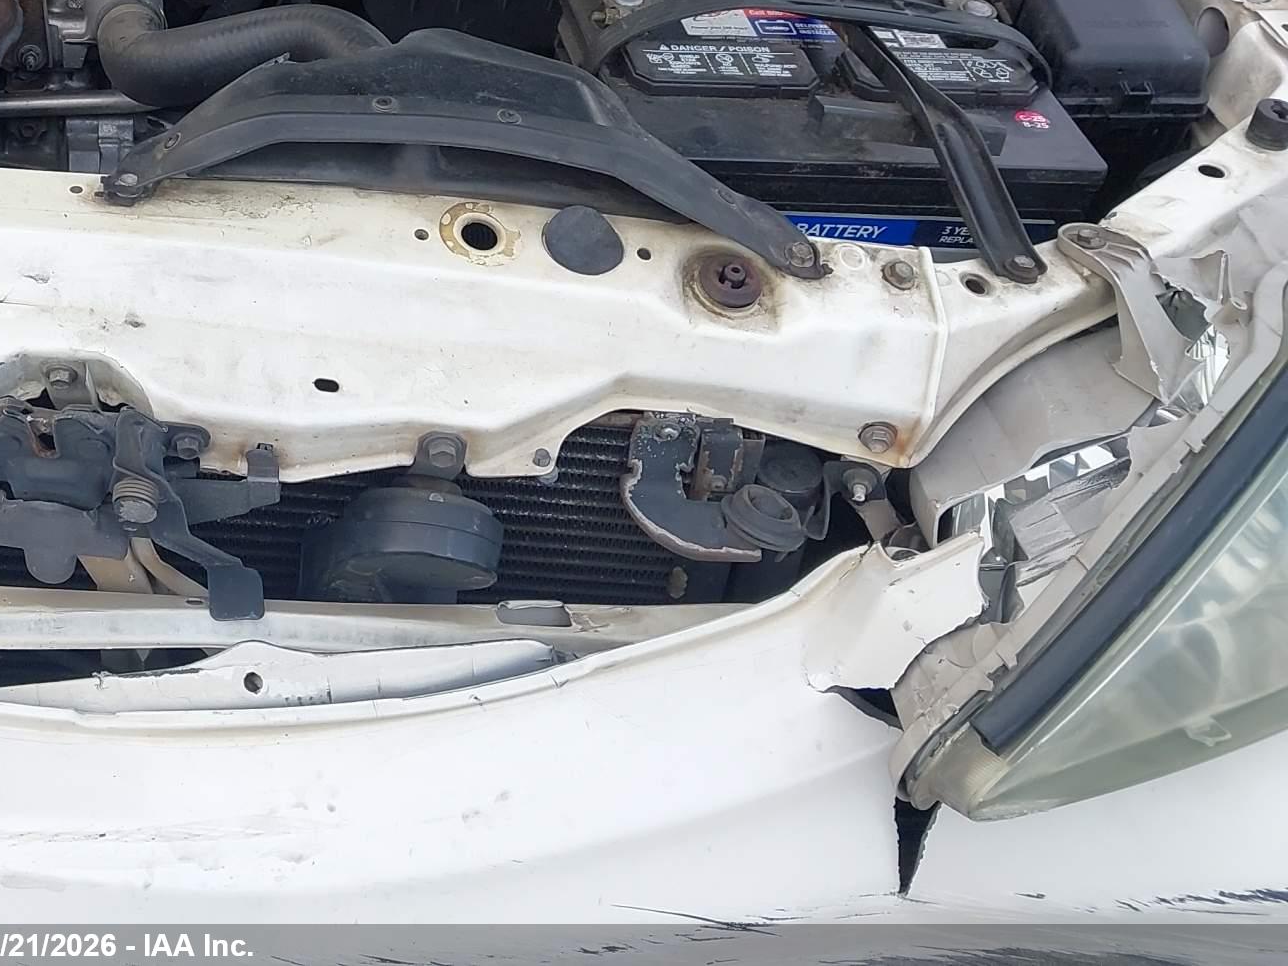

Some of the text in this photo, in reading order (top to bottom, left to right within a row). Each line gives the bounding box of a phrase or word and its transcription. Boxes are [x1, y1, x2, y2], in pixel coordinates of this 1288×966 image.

[670, 44, 716, 52] DANGER
[796, 223, 888, 239] BATTERY
[942, 226, 970, 236] 3 YE
[938, 236, 974, 244] REPLA
